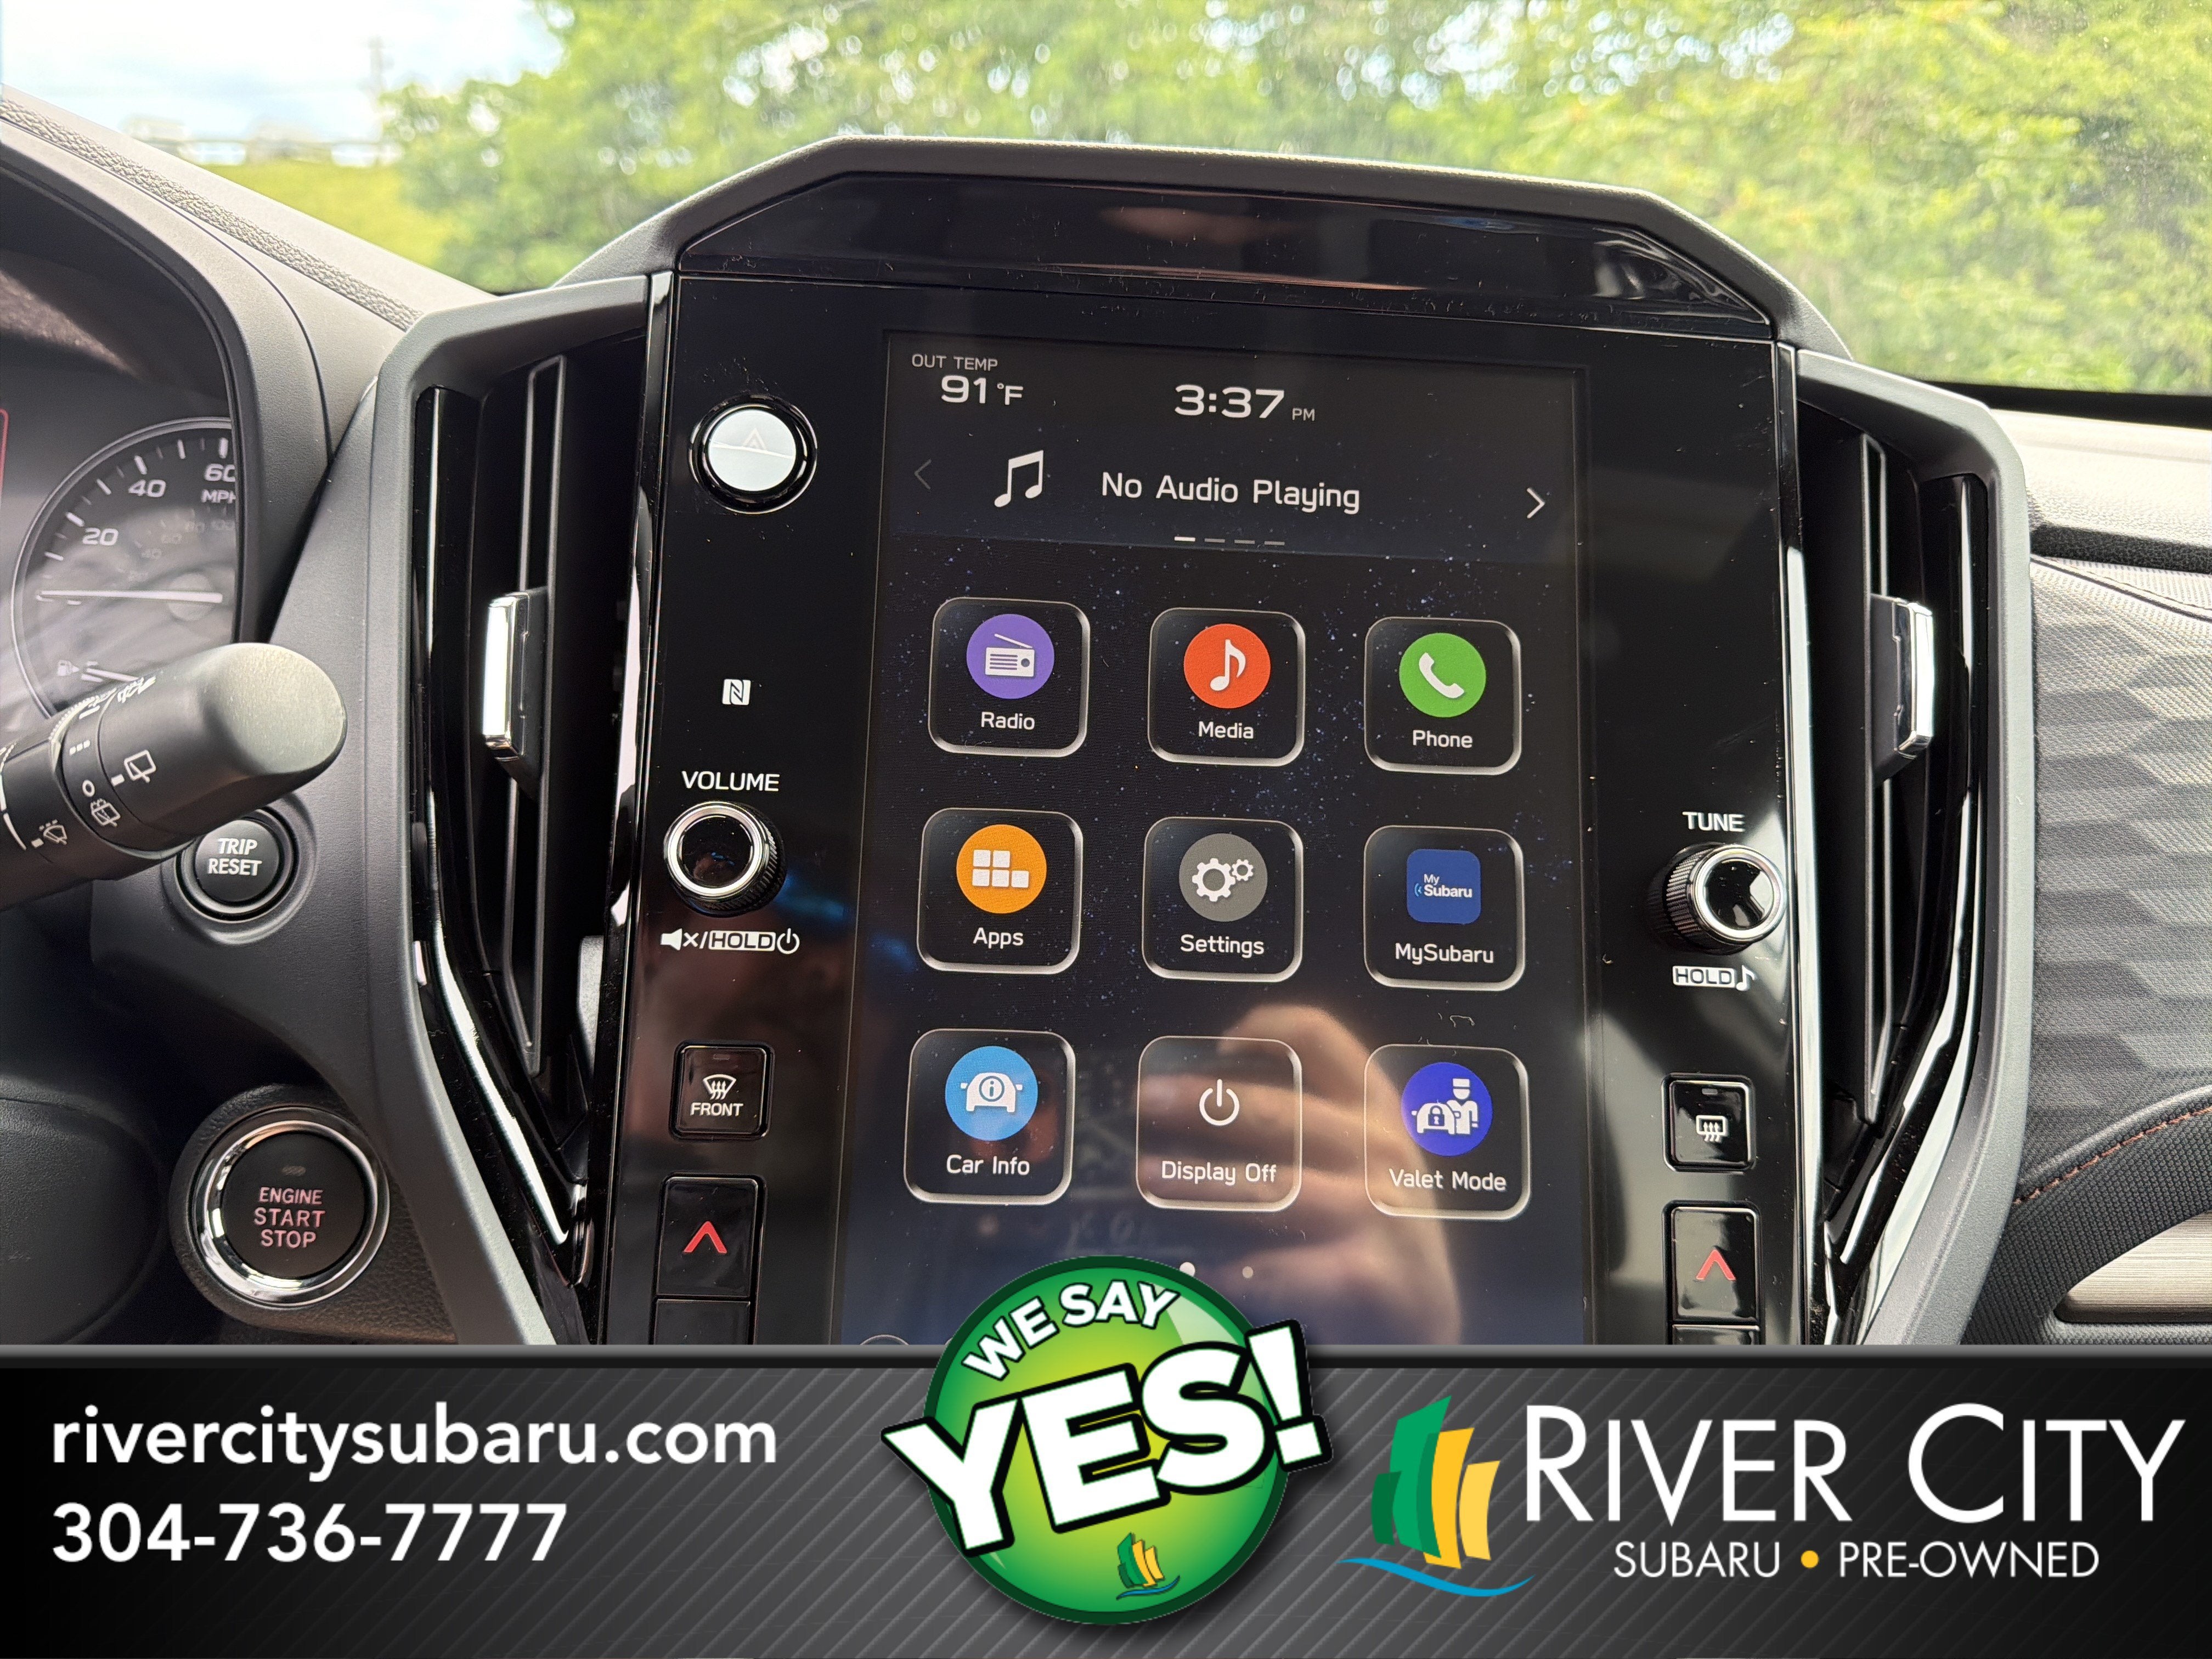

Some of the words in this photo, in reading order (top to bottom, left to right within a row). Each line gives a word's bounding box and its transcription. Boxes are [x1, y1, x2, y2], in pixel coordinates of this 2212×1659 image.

[912, 354, 947, 369] OUT
[953, 356, 998, 371] TEMP
[941, 375, 986, 404] 91
[1175, 384, 1285, 419] 3:37
[1292, 408, 1315, 421] PM
[128, 479, 166, 498] 40
[1102, 472, 1142, 498] No
[1155, 475, 1238, 503] Audio
[1253, 479, 1359, 515] Playing
[82, 527, 119, 546] 20
[981, 711, 1035, 730] Radio
[1198, 721, 1254, 739] Media
[1413, 730, 1473, 748] Phone
[681, 770, 780, 792] VOLUME
[1682, 811, 1746, 832] TUNE
[218, 837, 258, 855] TRIP
[207, 857, 263, 876] RESET
[1422, 872, 1441, 886] My
[1423, 883, 1474, 898] Subaru
[973, 927, 1024, 950] Apps
[1180, 934, 1265, 958] Settings
[1395, 943, 1494, 965] MySubaru
[1674, 967, 1734, 986] HOLD
[690, 1102, 744, 1116] FRONT
[946, 1154, 984, 1174] Car
[992, 1155, 1030, 1175] Info
[1161, 1160, 1236, 1186] Display
[1245, 1163, 1277, 1183] Off
[1389, 1168, 1444, 1189] Valet
[1452, 1171, 1507, 1191] Mode
[259, 1187, 324, 1205] ENGINE
[253, 1207, 326, 1228] START
[261, 1229, 317, 1249] STOP
